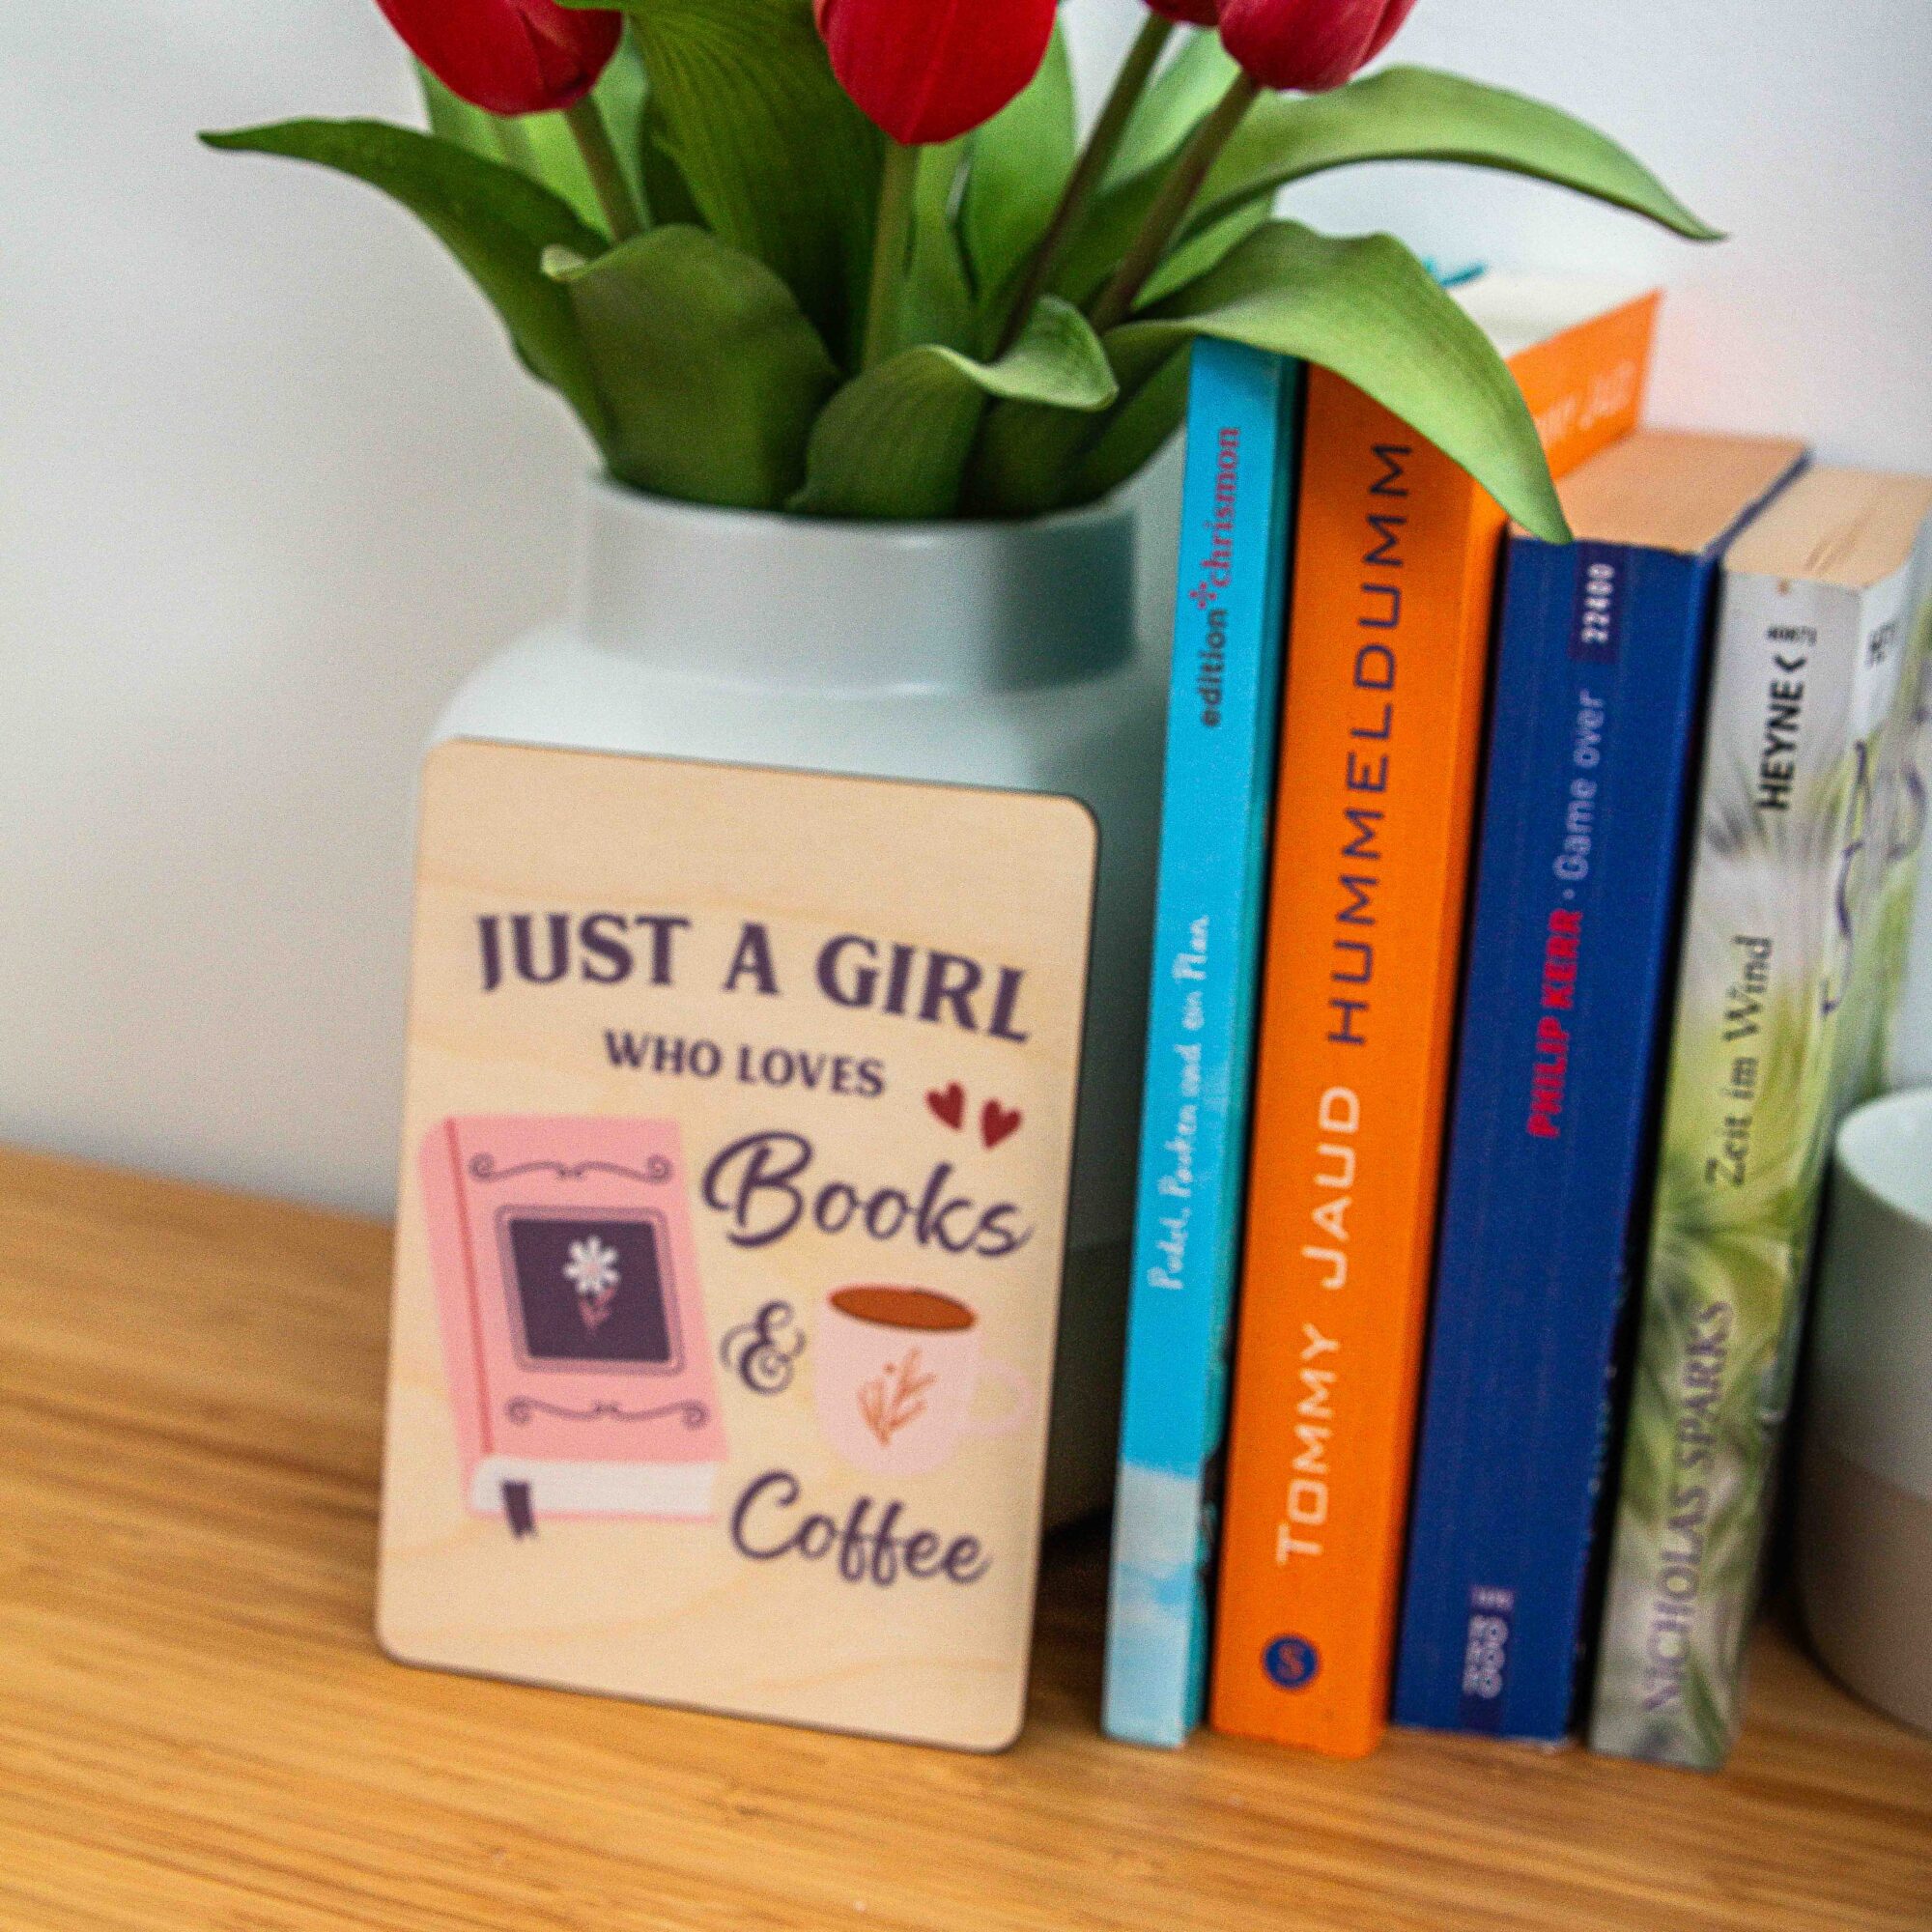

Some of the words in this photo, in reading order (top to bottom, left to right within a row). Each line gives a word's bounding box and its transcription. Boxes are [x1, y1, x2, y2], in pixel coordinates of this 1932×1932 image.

[1199, 427, 1241, 588] chrismon
[1195, 609, 1229, 728] edition
[1572, 689, 1605, 769] over
[1326, 443, 1414, 1047] HUMMELDUMM
[1753, 680, 1804, 812] HEYNE
[1550, 777, 1598, 882] Game
[476, 912, 693, 994] JUST
[721, 922, 781, 998] A
[814, 931, 1034, 1044] GIRL
[1542, 908, 1583, 1010] KERR
[1723, 933, 1775, 1044] Wind
[604, 1028, 724, 1079] WHO
[736, 1043, 886, 1098] LOVES
[1527, 1015, 1575, 1139] PHILIP
[1722, 1044, 1758, 1098] im
[700, 1129, 1034, 1258] Books
[1299, 1085, 1362, 1291] JAUD
[1704, 1105, 1753, 1187] Zeit
[720, 1299, 808, 1395] &
[1676, 1297, 1738, 1471] SPARKS
[1275, 1321, 1343, 1568] TOMMY
[729, 1468, 995, 1587] Coffee
[1642, 1483, 1714, 1716] NICHOLAS
